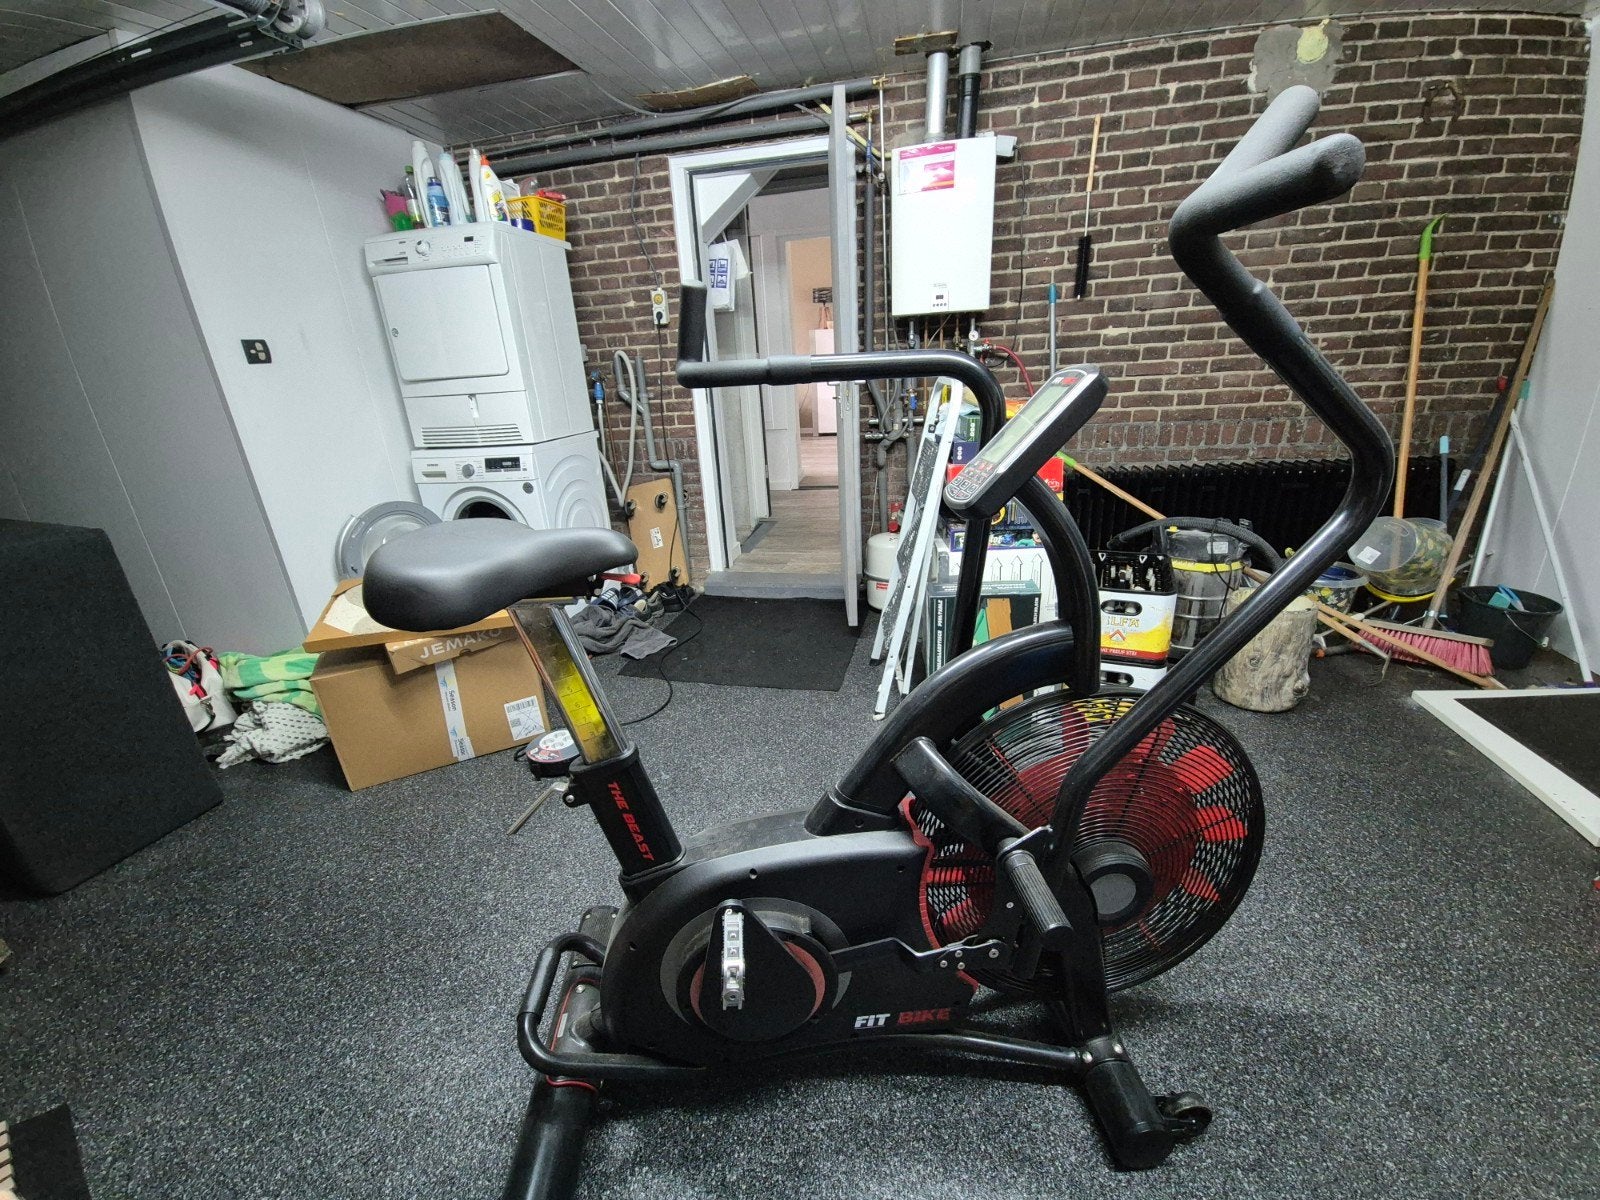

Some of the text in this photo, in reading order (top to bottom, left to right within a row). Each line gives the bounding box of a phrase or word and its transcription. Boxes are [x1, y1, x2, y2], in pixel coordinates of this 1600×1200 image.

[420, 628, 502, 659] JEMAKO
[607, 782, 655, 860] THE BEAST
[854, 1008, 951, 1029] FIT BIKE
